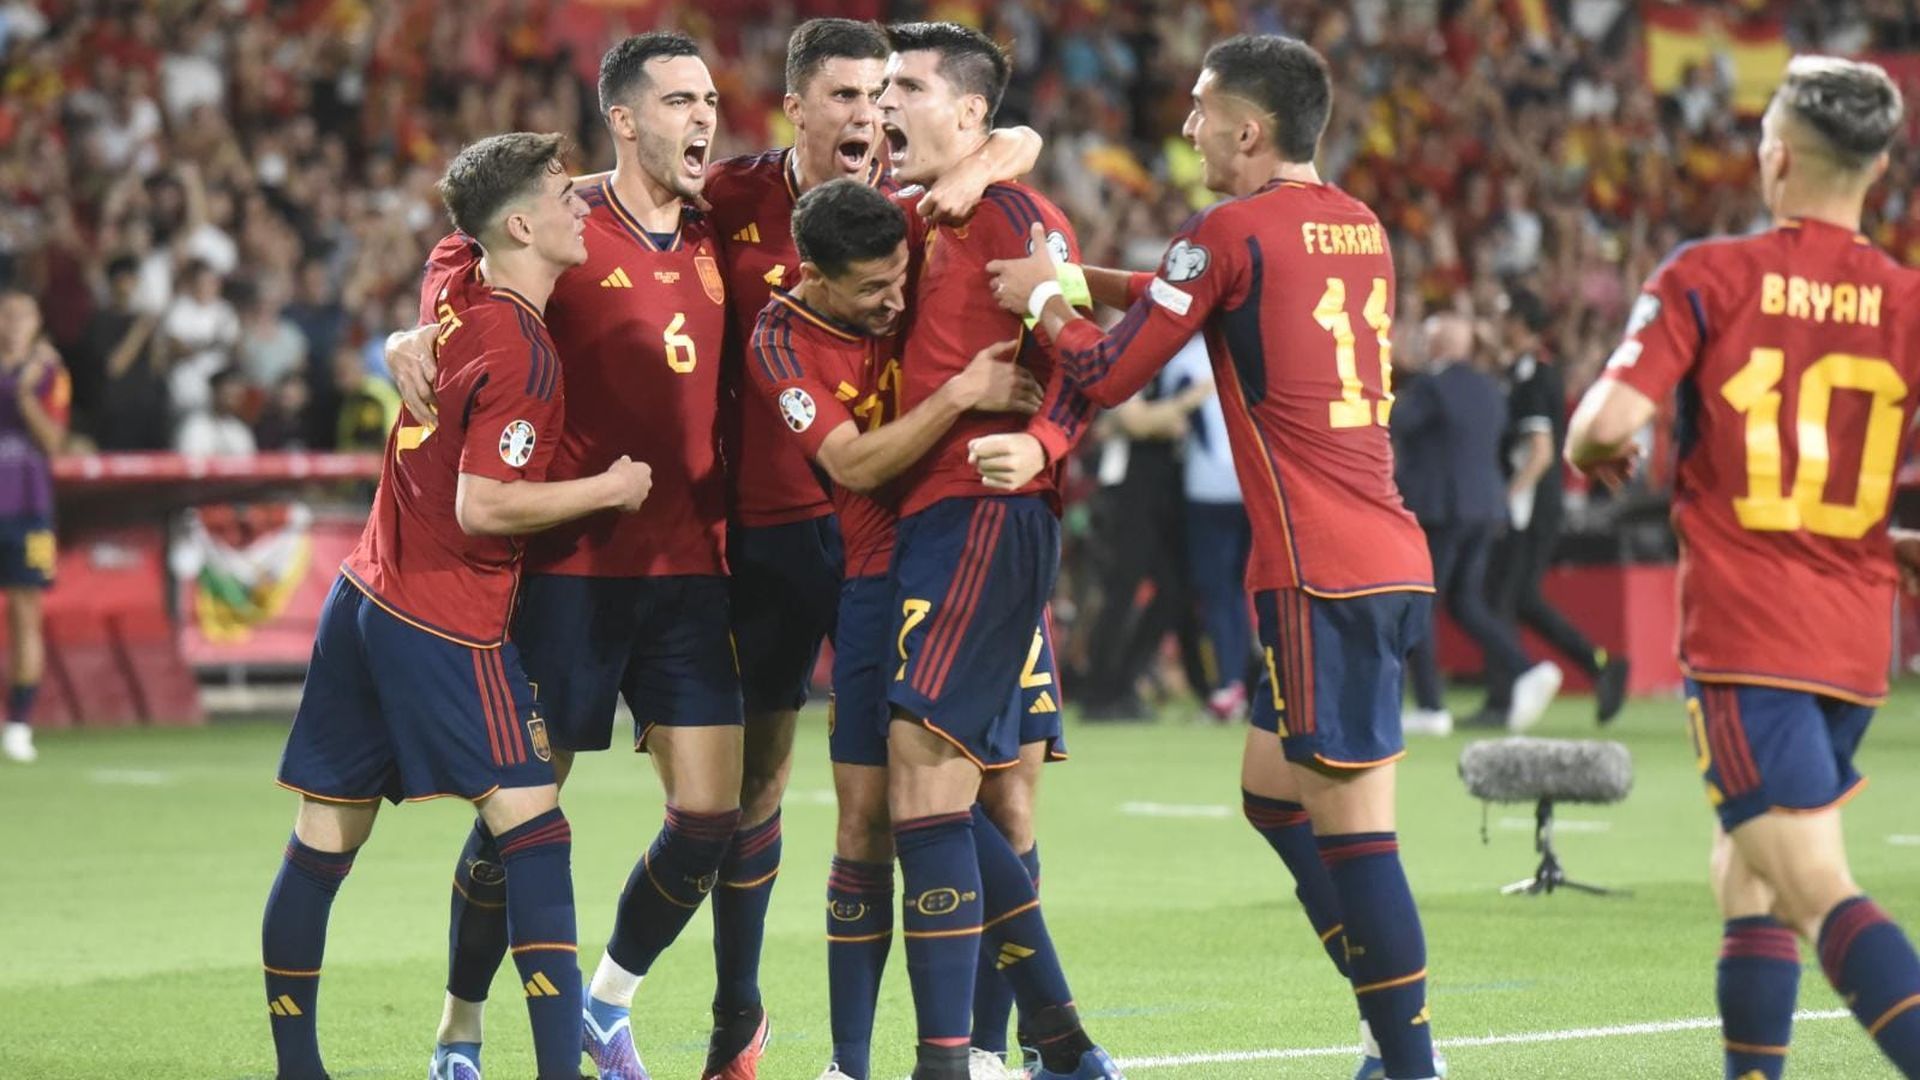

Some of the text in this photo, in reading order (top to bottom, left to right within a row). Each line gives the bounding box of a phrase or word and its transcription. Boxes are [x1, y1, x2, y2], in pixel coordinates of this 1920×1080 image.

[1301, 222, 1384, 255] FERRAN
[1760, 272, 1883, 327] BRYAN
[663, 312, 698, 374] 6
[1311, 277, 1396, 429] 11
[1720, 346, 1910, 541] 10
